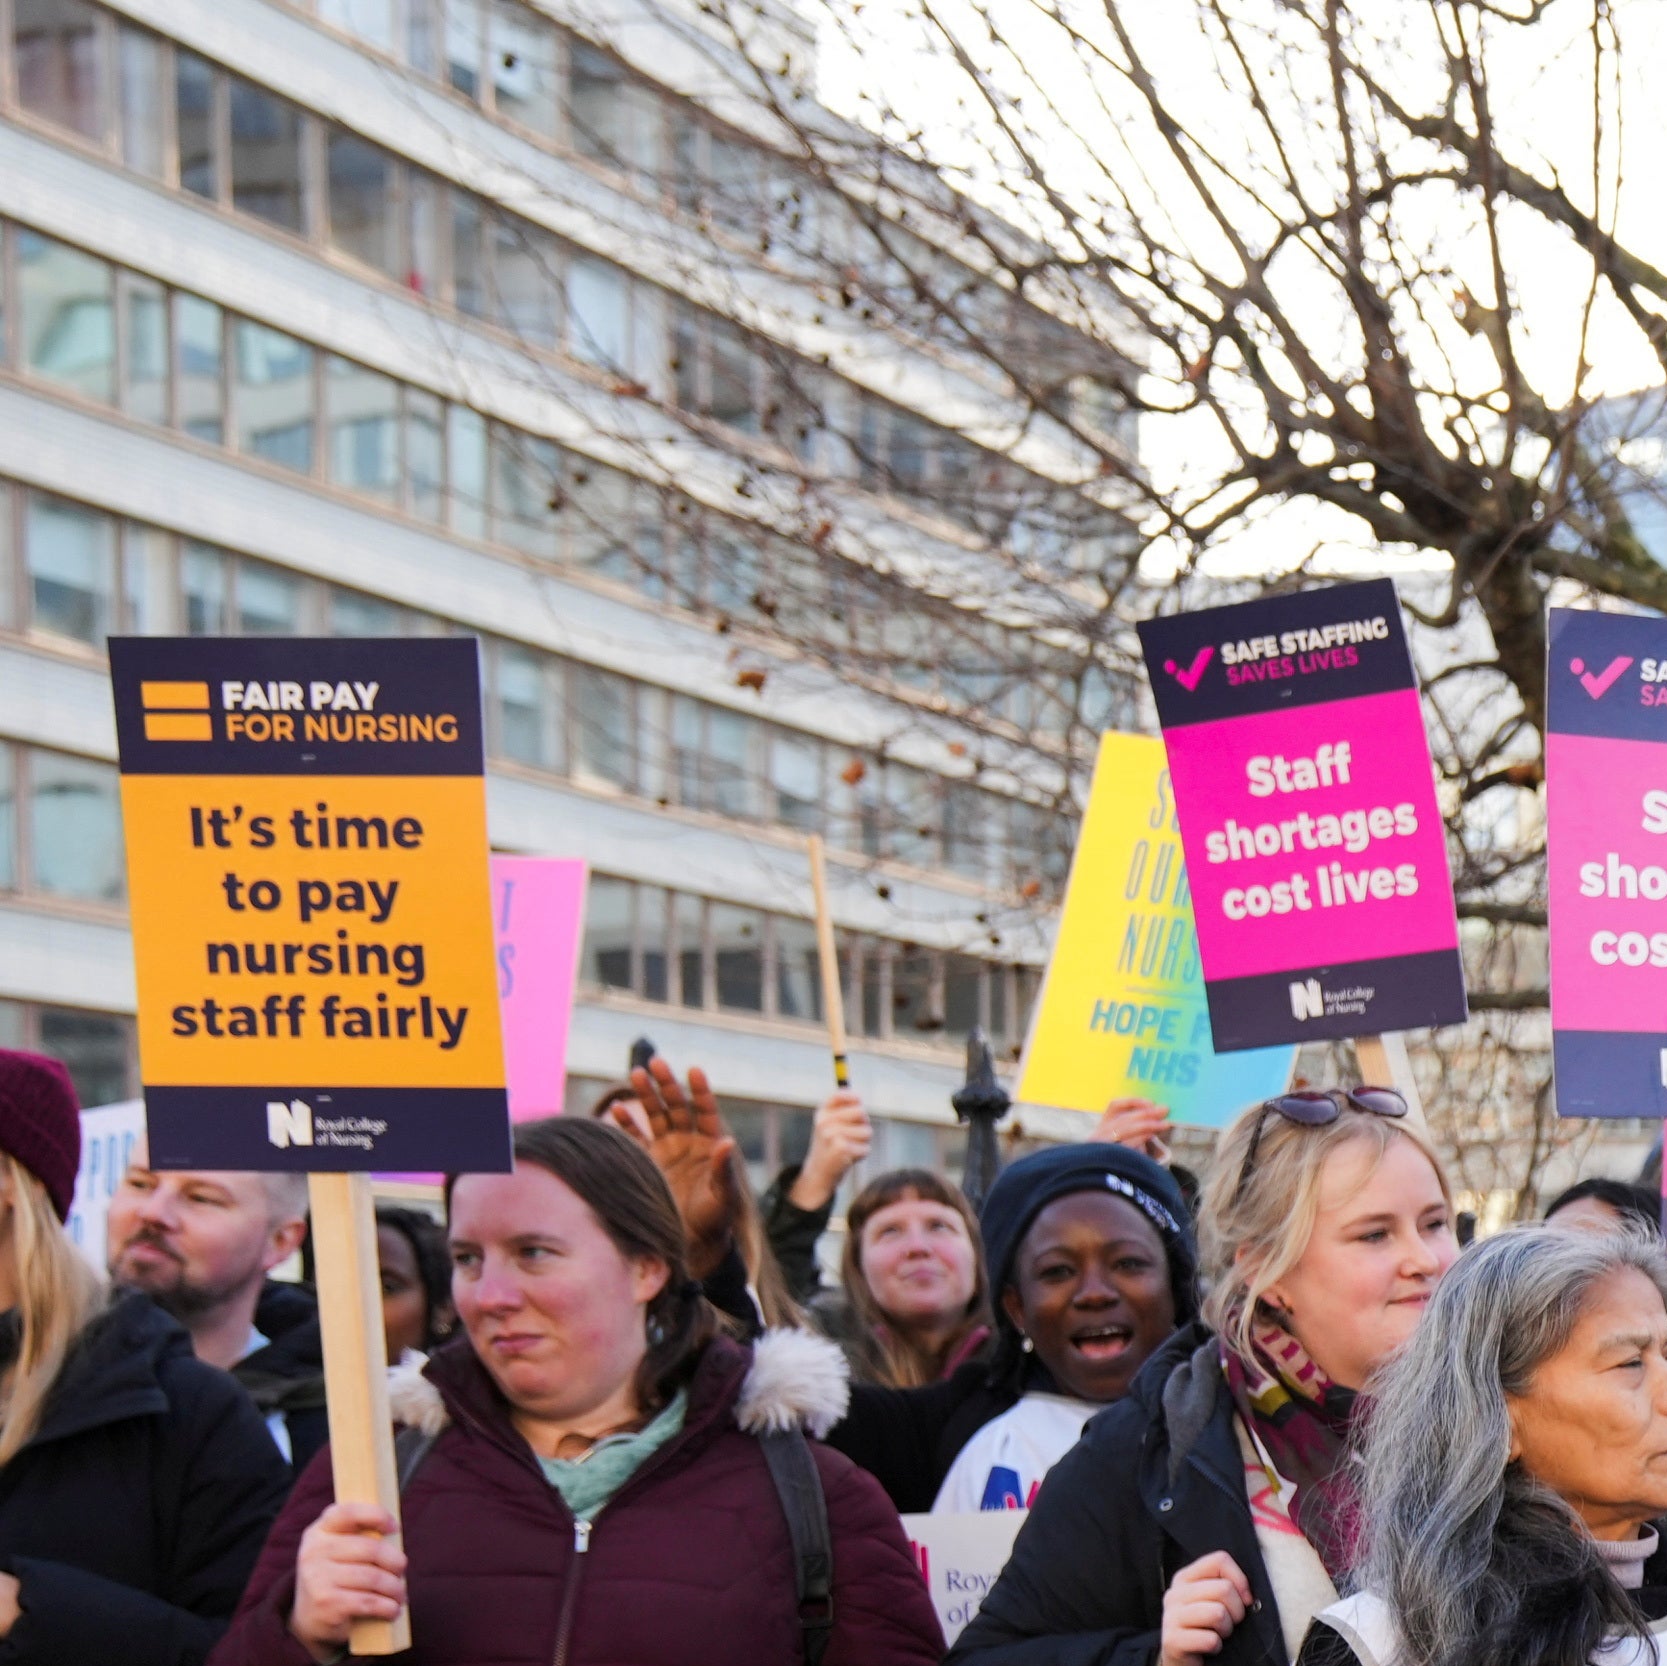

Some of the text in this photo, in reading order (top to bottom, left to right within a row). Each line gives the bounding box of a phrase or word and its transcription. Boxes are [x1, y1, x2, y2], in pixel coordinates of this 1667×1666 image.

[1220, 616, 1389, 666] SAFE STAFFING
[1225, 646, 1359, 687] SAVES LIVES
[222, 681, 379, 713] FAIR PAY
[226, 714, 459, 743] FOR NURSING
[1245, 741, 1351, 798] Staff
[190, 804, 424, 850] It's time
[1205, 802, 1418, 864] shortages
[222, 873, 400, 923] to pay
[1222, 860, 1419, 921] cost lives
[207, 930, 426, 986] nursing
[1117, 913, 1200, 985] NURS
[172, 997, 469, 1049] staff fairly
[1090, 999, 1182, 1044] HOPE
[1126, 1046, 1202, 1089] NHS
